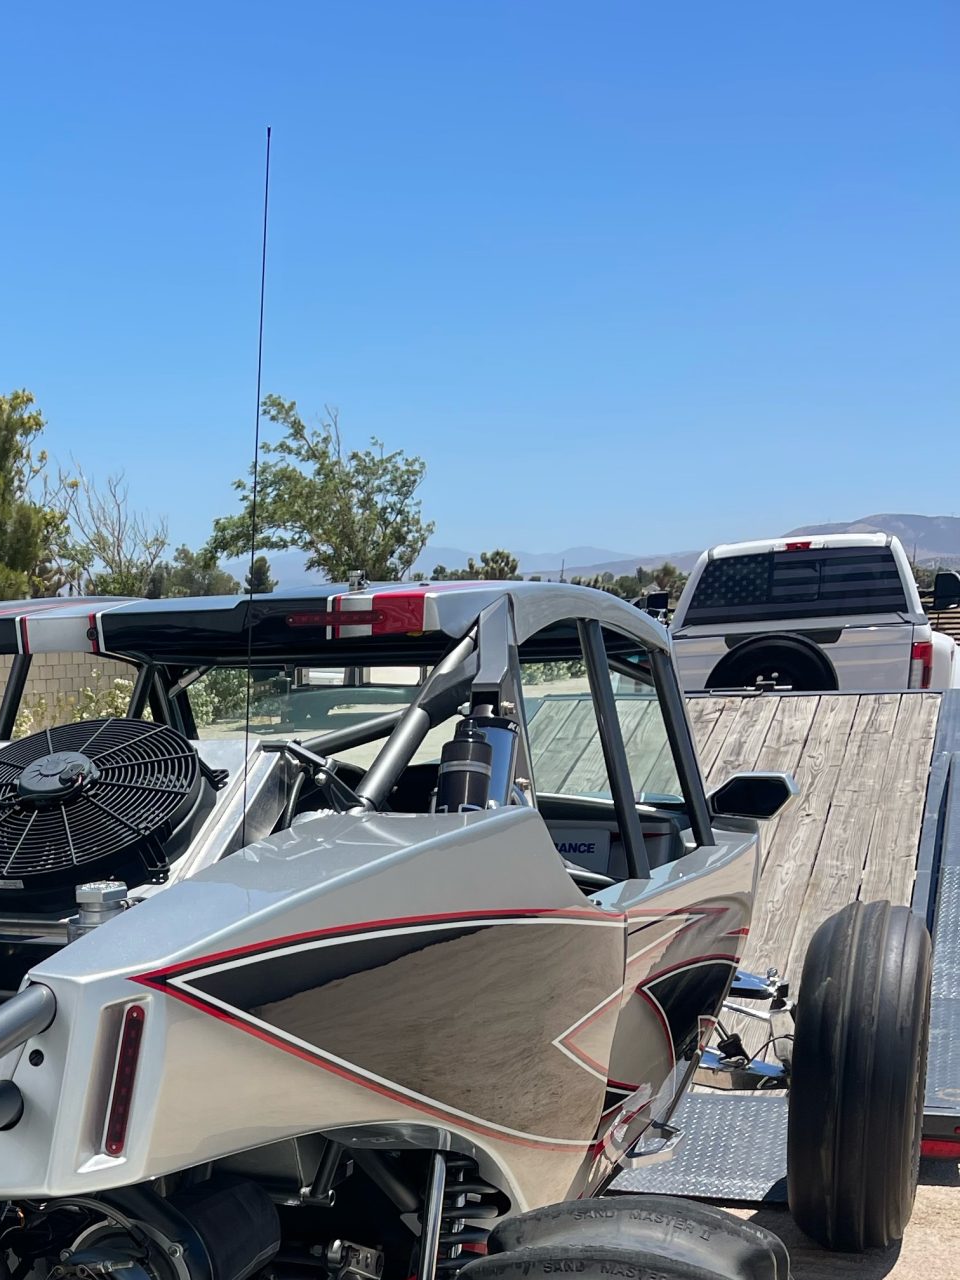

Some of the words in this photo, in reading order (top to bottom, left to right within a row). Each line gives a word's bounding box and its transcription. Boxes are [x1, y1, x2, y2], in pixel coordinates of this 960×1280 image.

[573, 1209, 616, 1221] SAND
[629, 1210, 694, 1234] MASTER
[543, 1260, 586, 1273] SAND
